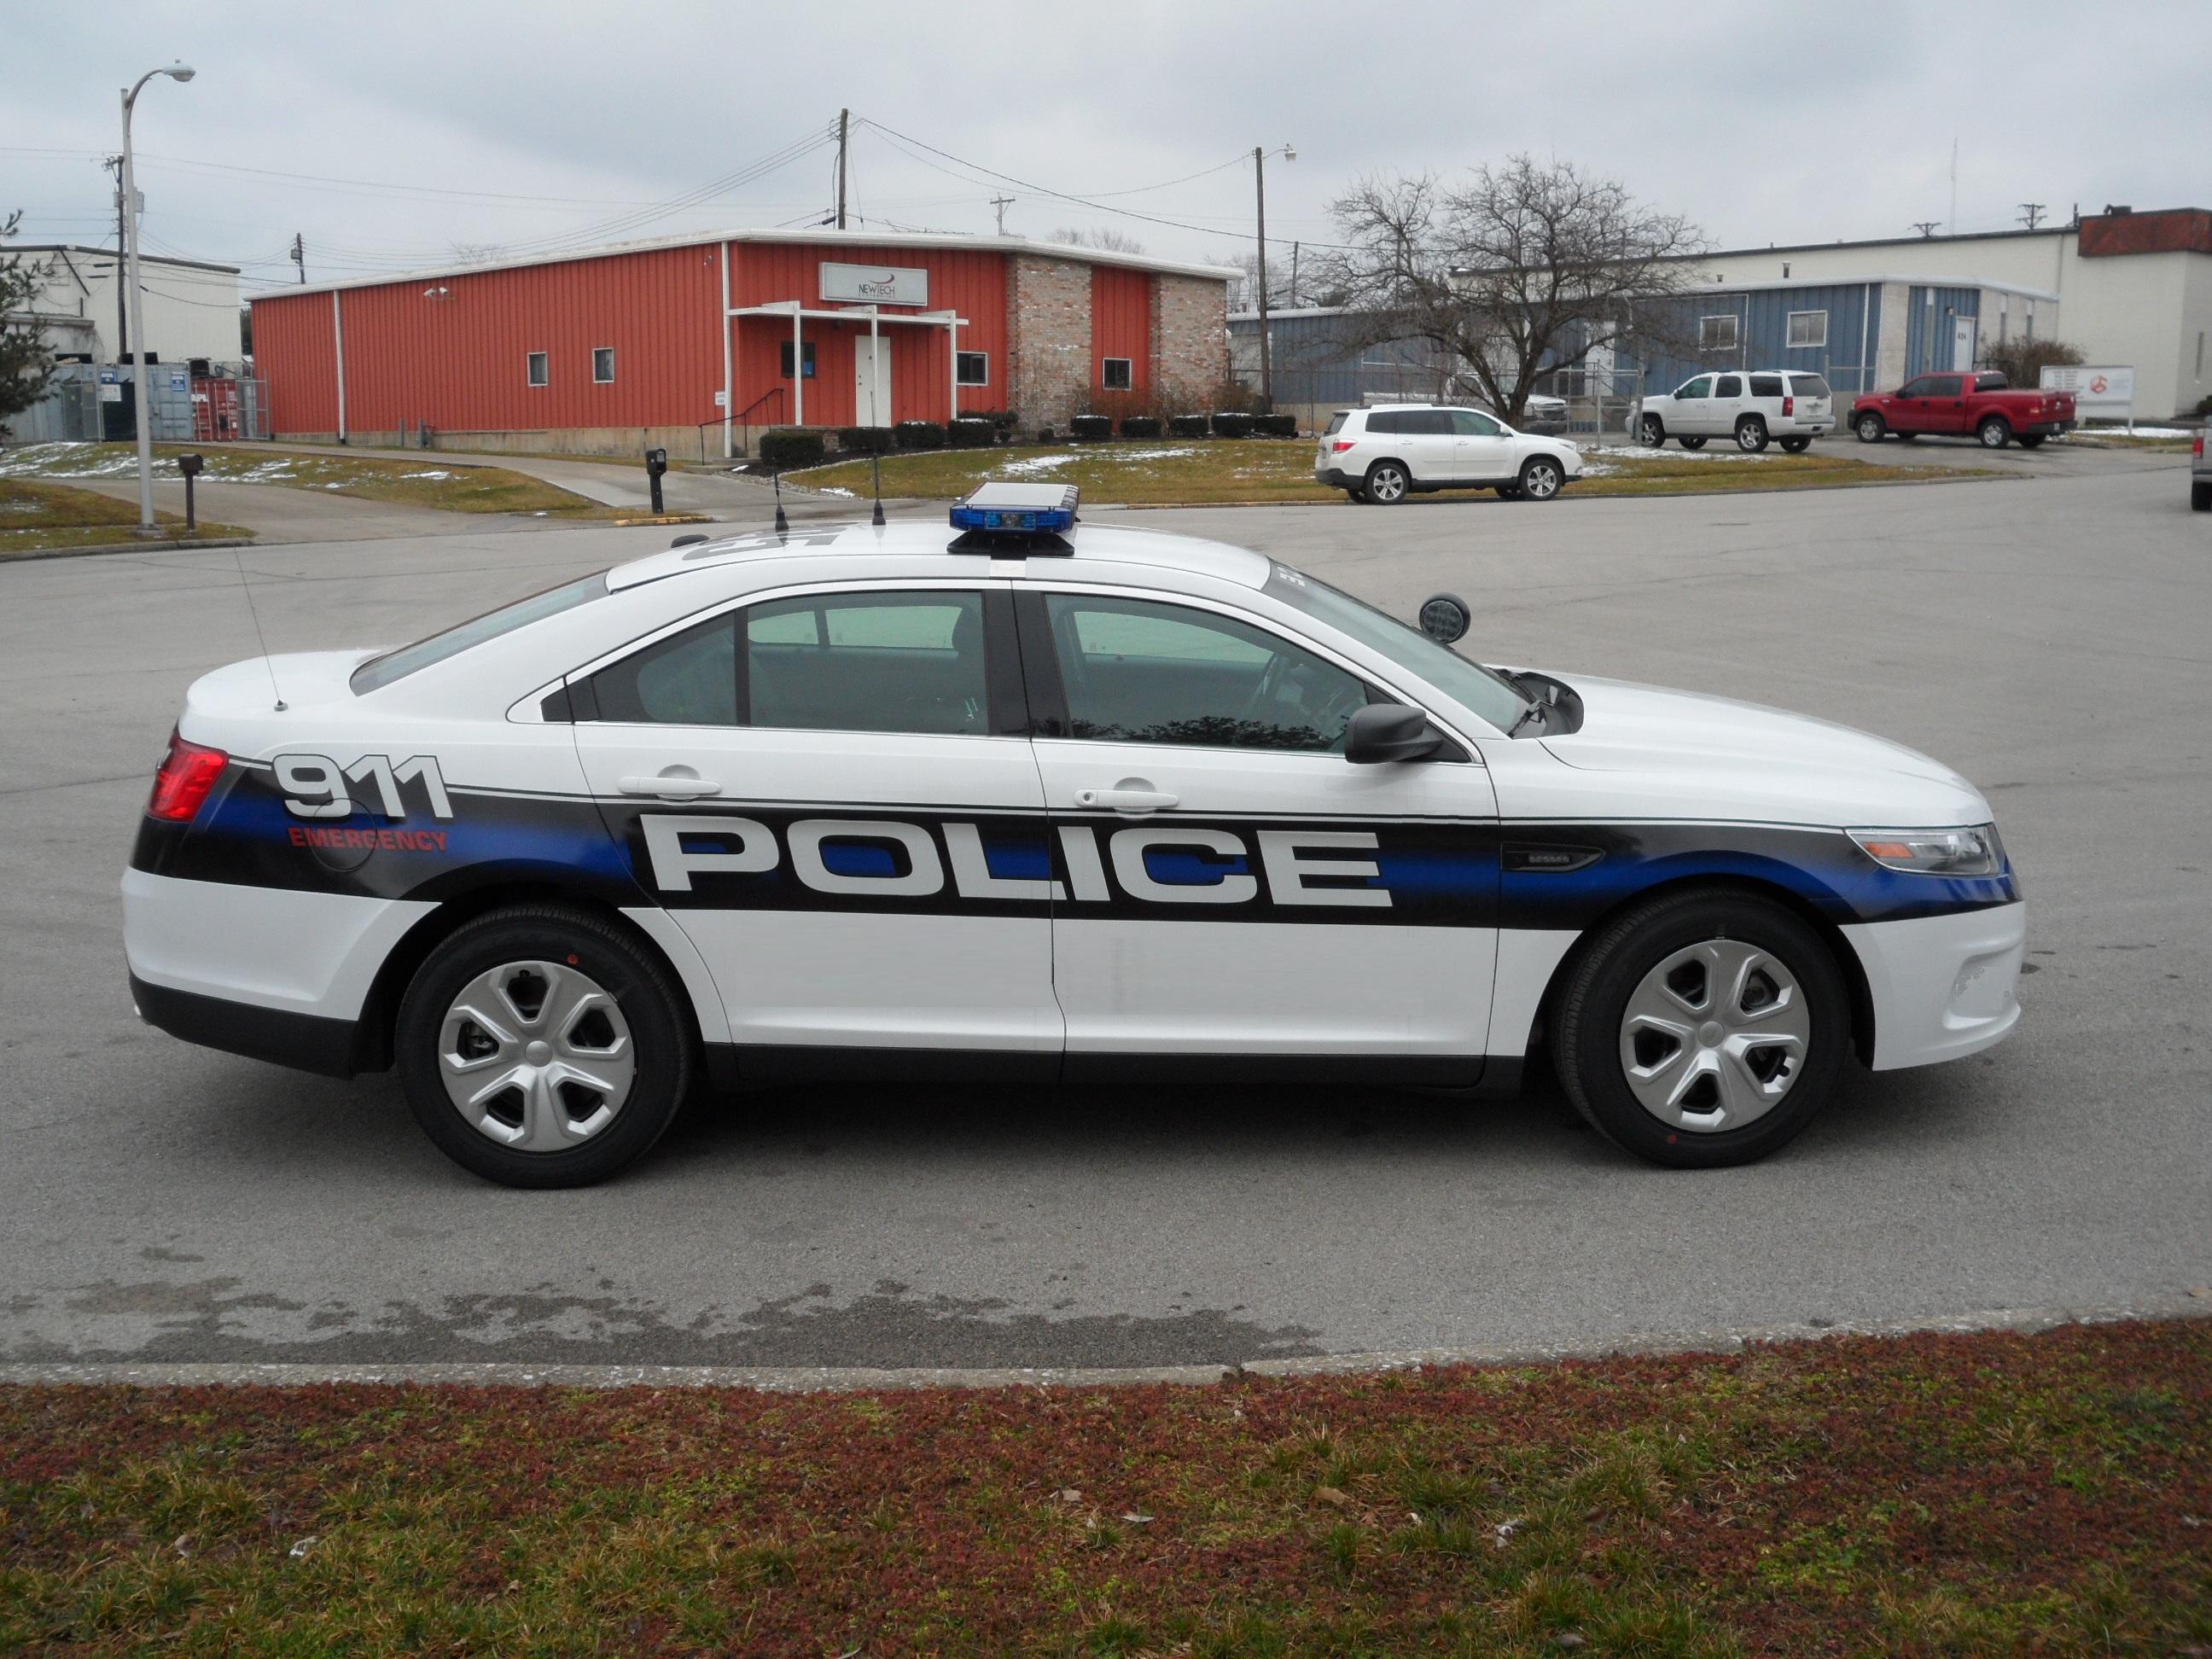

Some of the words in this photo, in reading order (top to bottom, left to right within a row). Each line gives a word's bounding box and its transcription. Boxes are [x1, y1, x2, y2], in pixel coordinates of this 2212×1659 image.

[273, 753, 454, 819] 911
[288, 827, 448, 852] EMERGENCY
[639, 813, 1393, 907] POLICE
